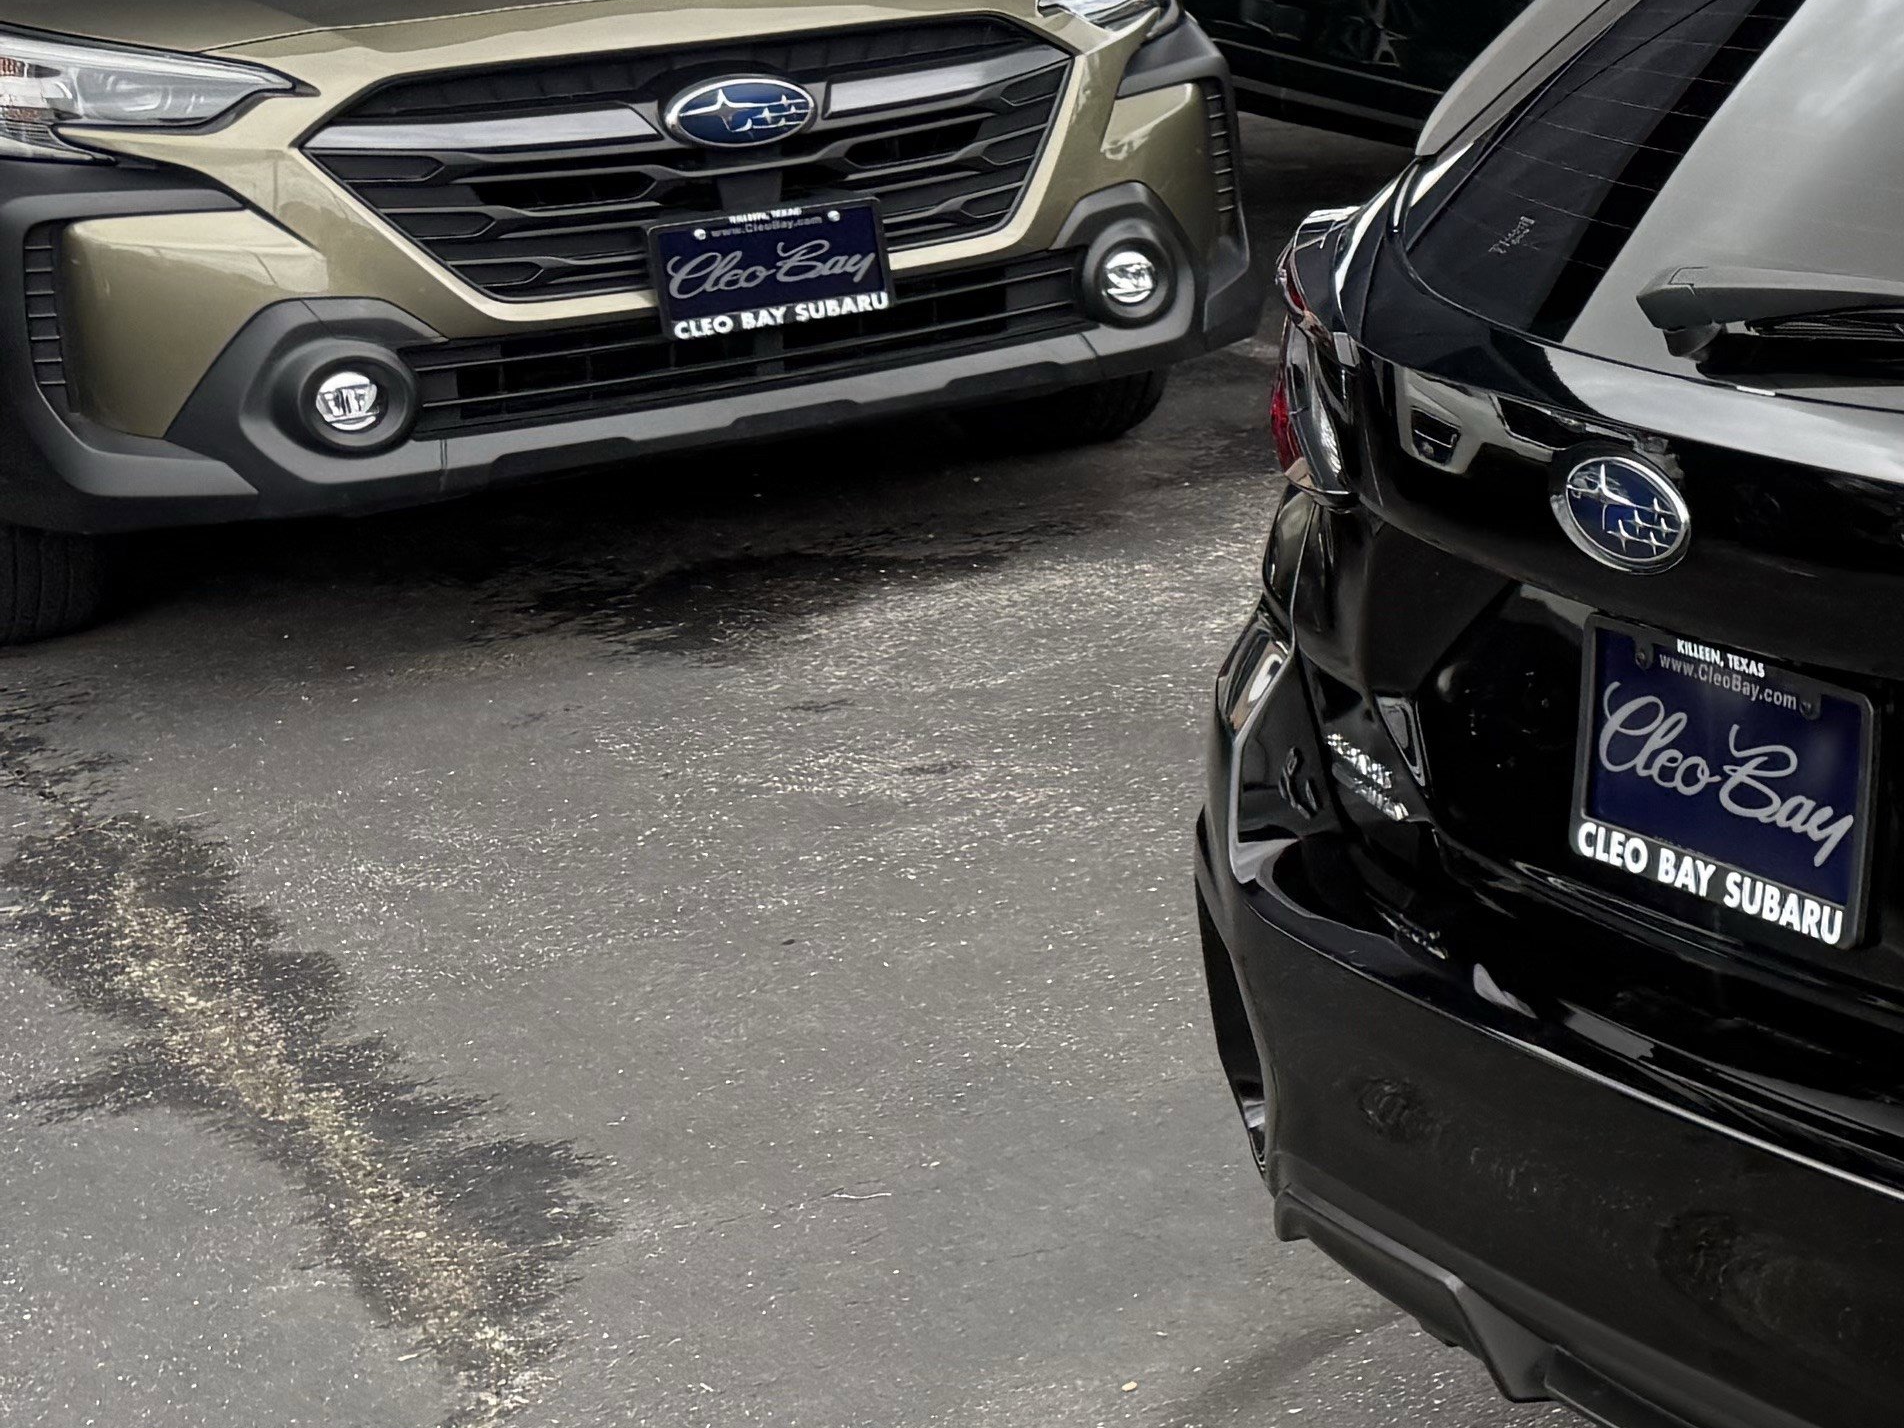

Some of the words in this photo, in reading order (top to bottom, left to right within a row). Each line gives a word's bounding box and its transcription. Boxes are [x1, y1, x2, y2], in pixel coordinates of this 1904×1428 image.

[667, 250, 774, 300] Cleo
[775, 239, 875, 284] Bay
[674, 316, 734, 341] CLEO
[741, 305, 787, 330] BAY
[794, 292, 889, 323] SUBARU
[1659, 654, 1797, 711] www.CleoBay.com
[1676, 638, 1724, 667] KILLEEN,
[1726, 653, 1765, 678] TEXAS
[1598, 681, 1721, 796] Cleo
[1718, 724, 1854, 867] Bay
[1578, 822, 1648, 874] CLEO
[1658, 849, 1716, 899] BAY
[1724, 872, 1843, 945] SUBARU
